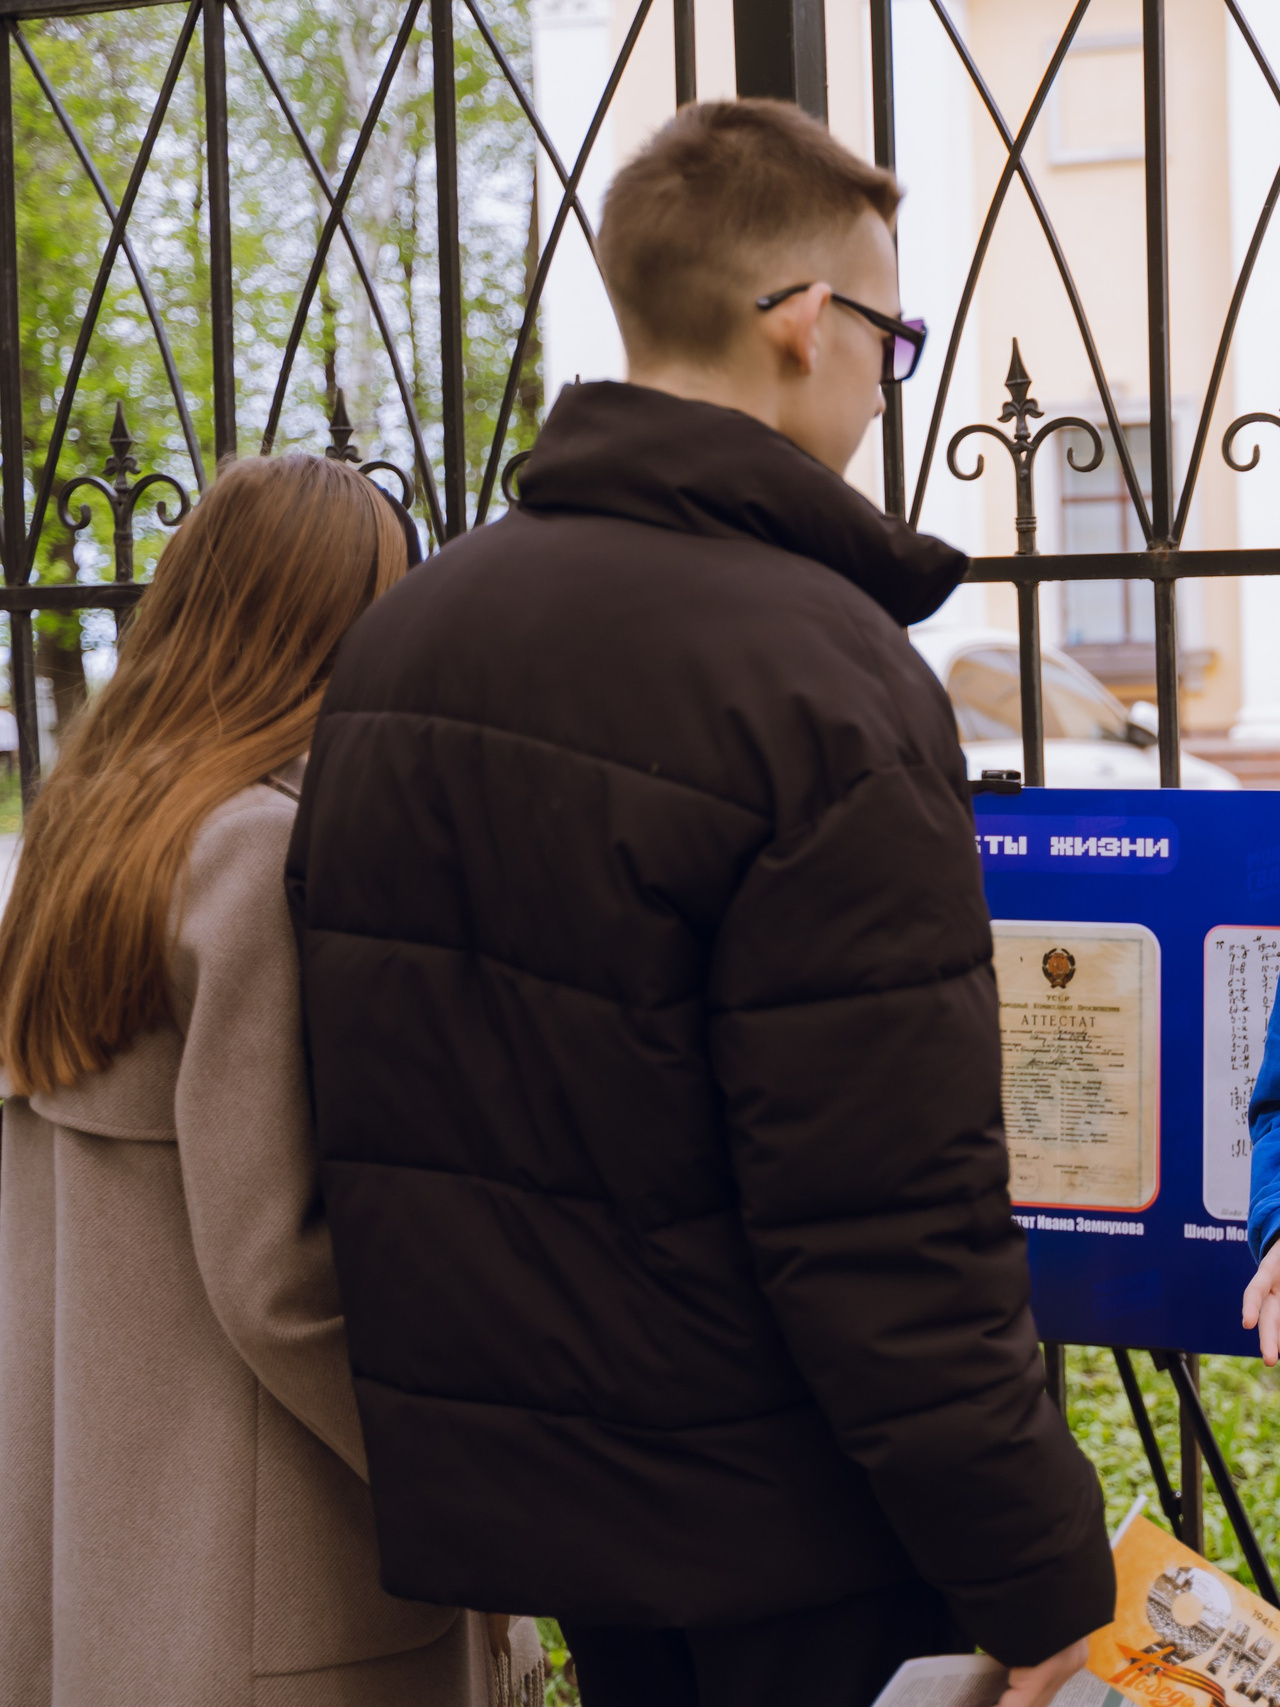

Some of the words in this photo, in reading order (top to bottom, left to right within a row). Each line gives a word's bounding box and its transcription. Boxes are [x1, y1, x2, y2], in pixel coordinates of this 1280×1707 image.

[1051, 836, 1169, 857] жизни
[1021, 1015, 1095, 1027] АТТЕСТАТ
[1037, 1215, 1075, 1231] Ивана
[1076, 1217, 1144, 1235] Земнухова
[1184, 1224, 1223, 1241] Шифр
[1252, 1609, 1274, 1629] 1941
